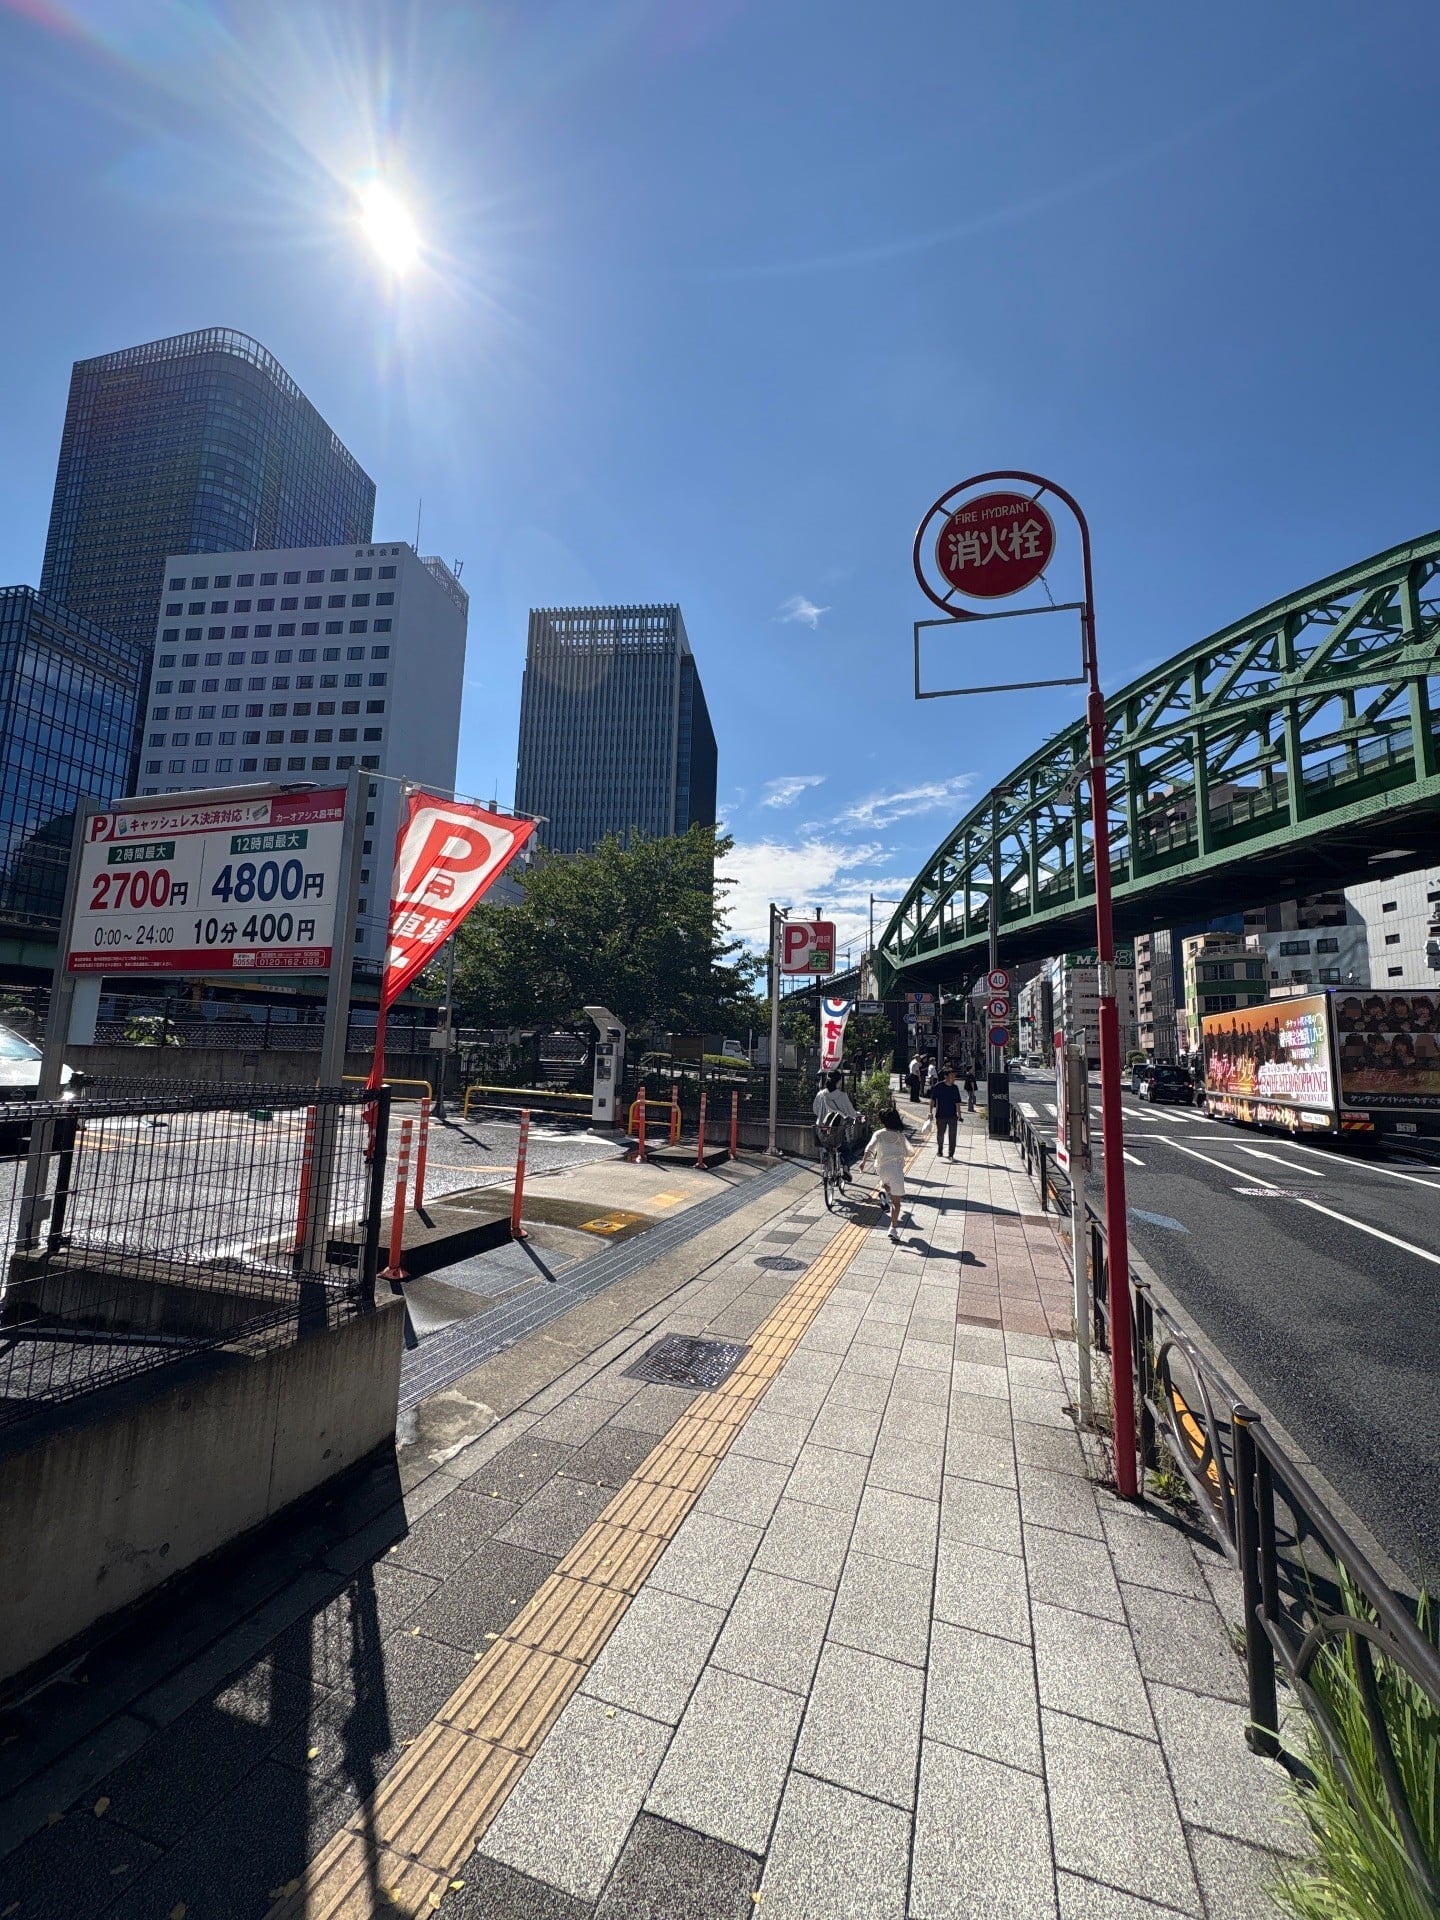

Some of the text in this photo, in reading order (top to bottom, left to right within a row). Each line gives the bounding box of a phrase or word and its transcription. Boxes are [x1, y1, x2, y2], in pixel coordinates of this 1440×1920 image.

[955, 502, 1030, 525] FIRE HYDRANT
[947, 518, 1044, 572] 消火栓
[91, 816, 112, 842] P
[237, 832, 300, 851] 12時間最大
[115, 847, 167, 862] 2時間最大
[404, 819, 492, 894] P
[89, 868, 189, 911] 2700円
[212, 858, 325, 904] 4800円
[785, 925, 809, 964] P
[992, 975, 1004, 985] 40
